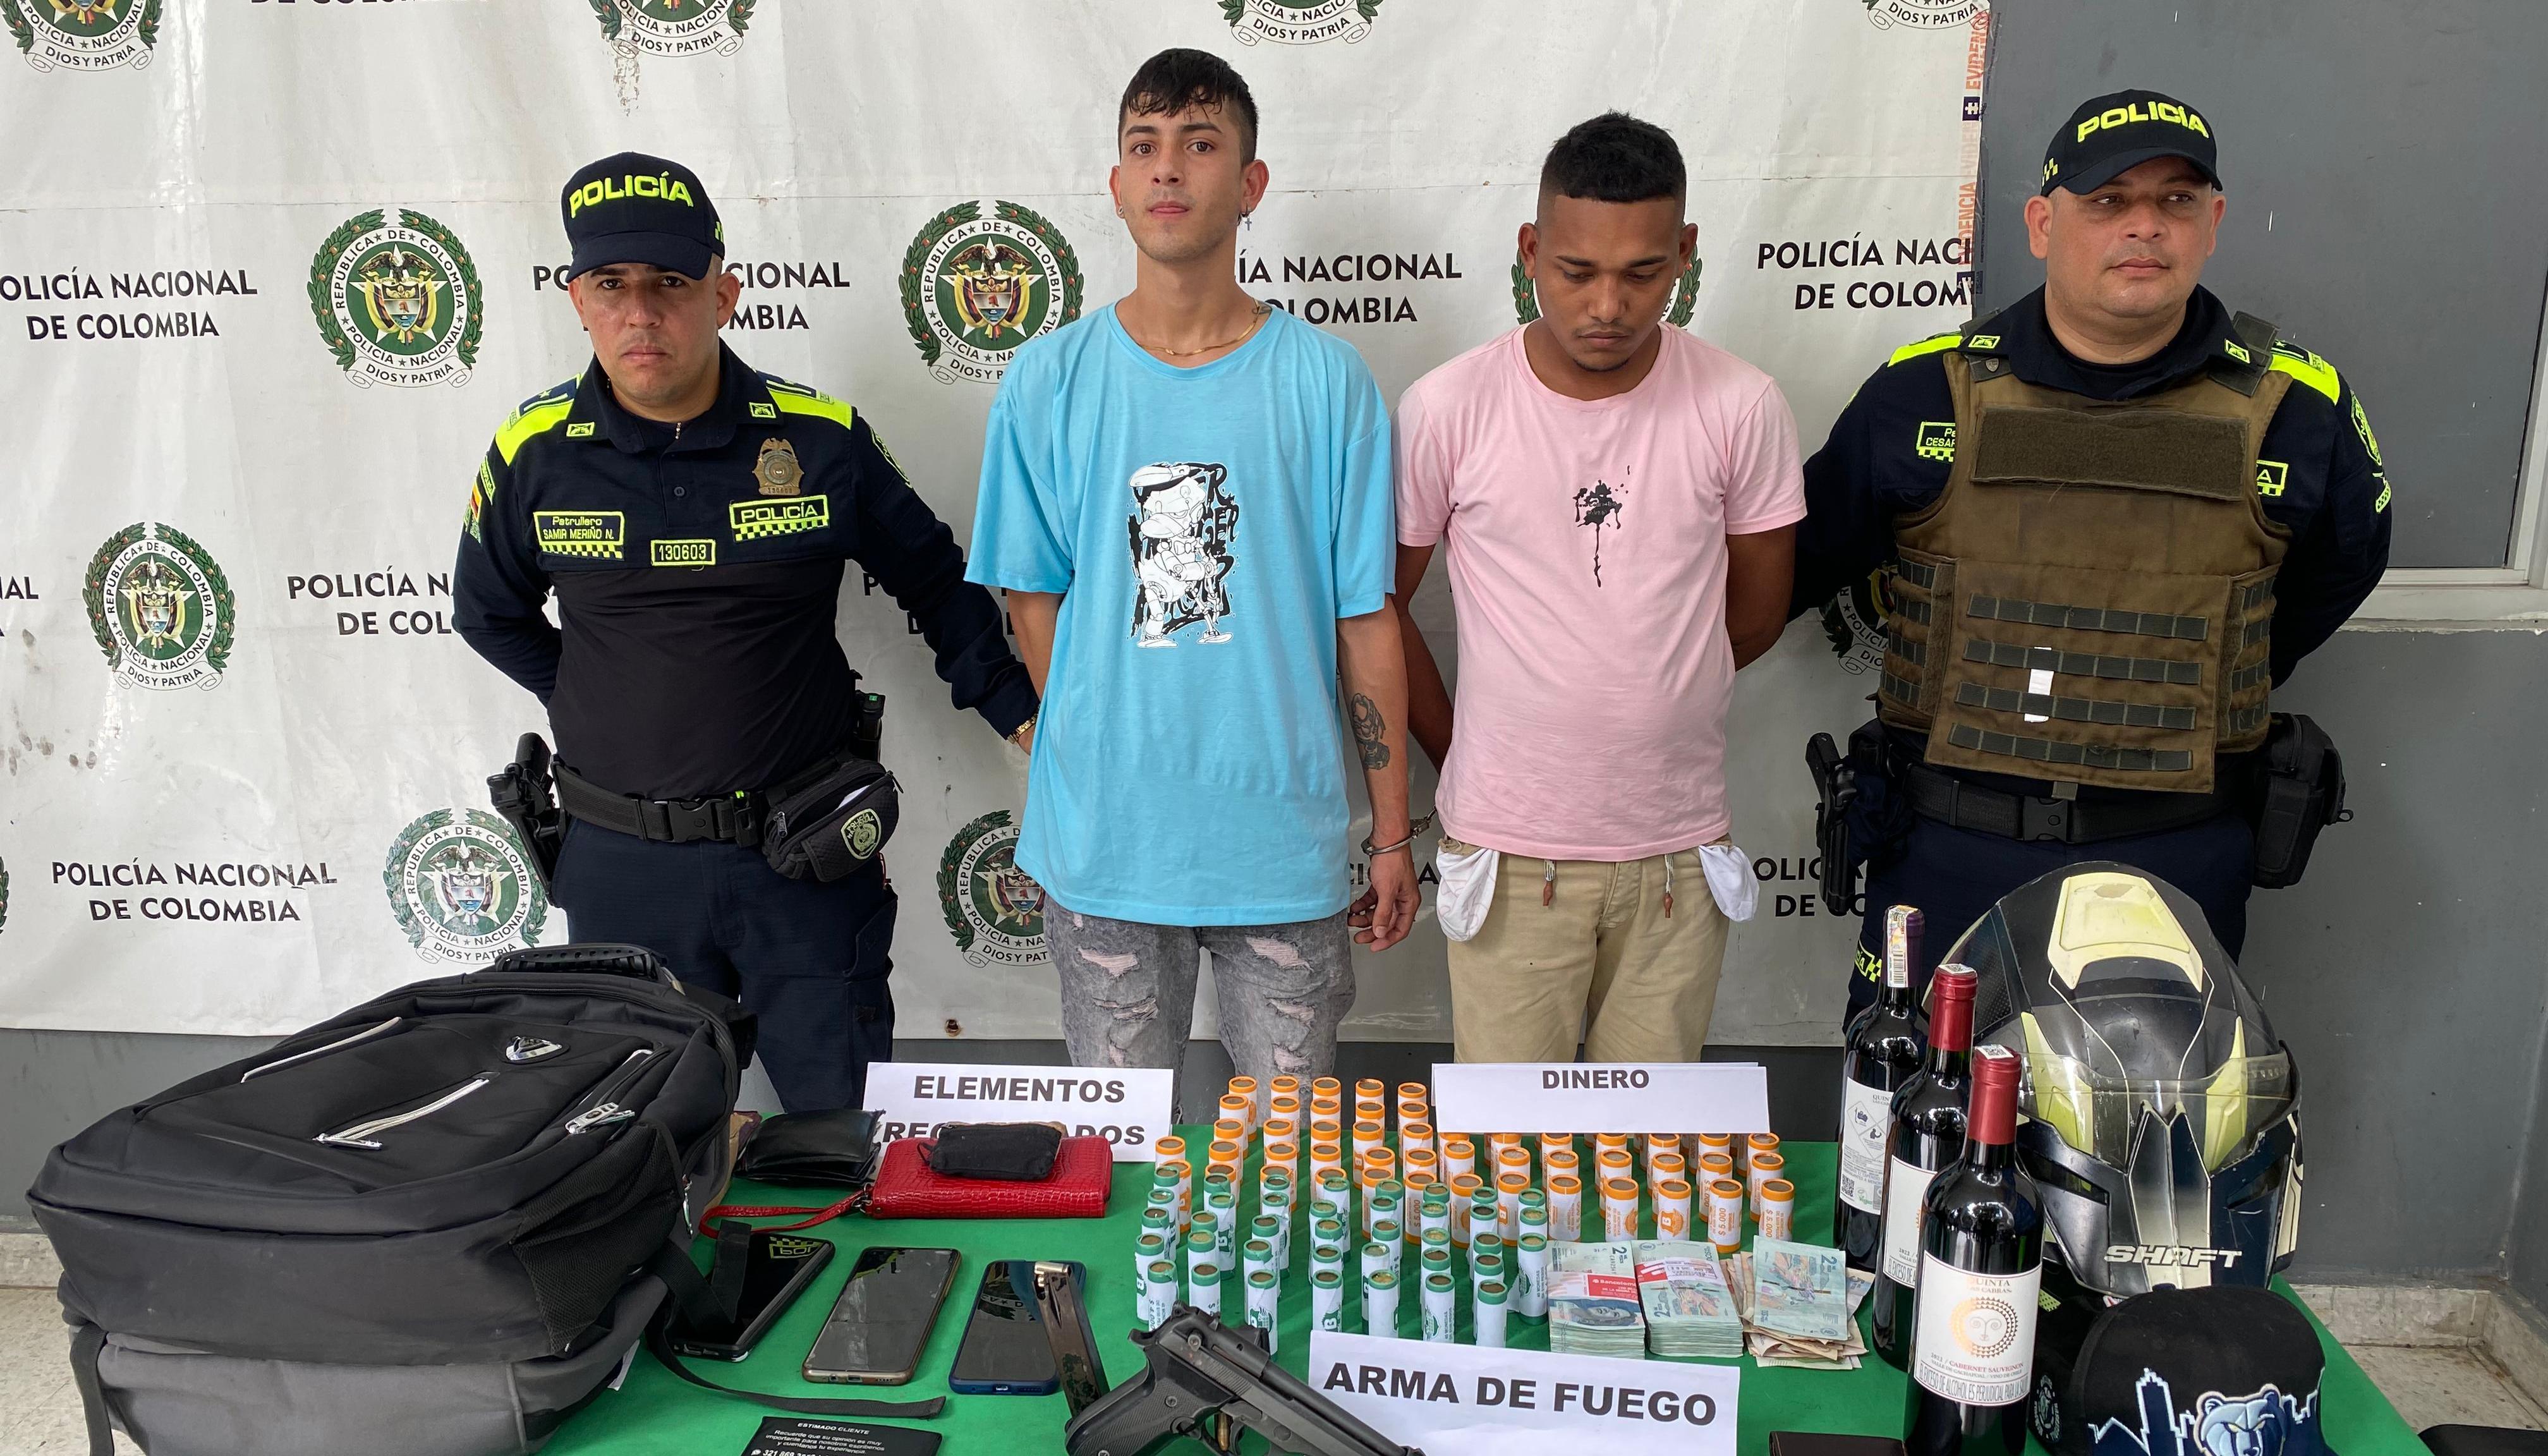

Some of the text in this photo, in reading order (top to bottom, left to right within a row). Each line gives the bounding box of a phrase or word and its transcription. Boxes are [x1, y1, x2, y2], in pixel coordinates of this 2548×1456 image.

[620, 0, 727, 33] OLICÍA NACION
[1302, 0, 1345, 21] NACIO
[1933, 3, 1978, 25] PATRIA
[92, 3, 143, 48] NACIONAL
[1302, 17, 1350, 40] PATRIA
[677, 30, 723, 52] PATRIA
[95, 44, 136, 66] PATRIA
[2078, 101, 2209, 143] POLICÍA
[570, 171, 694, 219] POLICÍA
[925, 222, 1060, 303] REPÚBLICA DE COLOMBIA
[1758, 232, 1972, 269] POLICÍA NACI
[334, 230, 464, 308] REPÚBLICA DE COLOMBIA
[725, 262, 850, 289] CIONAL
[1283, 253, 1462, 282] NACIONAL
[0, 266, 257, 301] OLICÍA NACIONAL
[1795, 280, 1972, 310] DE COLOM
[27, 311, 219, 341] DE COLOMBIA
[729, 303, 809, 330] MBIA
[410, 325, 462, 367] NACIONAL
[412, 363, 453, 384] PATRIA
[552, 516, 602, 526] Patrullero
[741, 502, 818, 523] POLICÍA
[543, 529, 567, 540] SAMIR
[569, 526, 602, 540] MERIÑO
[658, 544, 707, 561] 130603
[106, 542, 214, 617] REPÚBLICA DE COLOMBIA
[289, 565, 420, 599] POLICÍA
[337, 612, 381, 636] DE
[161, 631, 212, 671] NACIONAL
[1860, 650, 1884, 666] DIO
[162, 669, 203, 687] PATRIA
[52, 857, 337, 887] POLICÍA NACIONAL
[406, 827, 529, 896] REPÚBLICA DE COLOMBIA
[960, 833, 1000, 895] REPÚBLICA
[89, 897, 300, 922] DE COLOMBIA
[1775, 894, 1816, 917] DE
[475, 910, 526, 946] NACIONAL
[1026, 951, 1048, 962] PAT
[914, 1076, 1125, 1103] ELEMENTOS
[1542, 1069, 1649, 1089] DINERO
[1872, 1094, 1891, 1102] QUIN
[883, 1122, 1145, 1145] RECDOS
[2103, 1244, 2242, 1268] SHAFT
[1950, 1361, 1987, 1373] CABERNET
[1988, 1362, 2023, 1373] SAUVIGNON
[1324, 1362, 1716, 1426] ARMA DE FUEGO
[1924, 1368, 1939, 1388] EXCESO
[1939, 1374, 1946, 1390] DE
[1946, 1376, 1967, 1398] ALCOHOL
[765, 1434, 848, 1448] importante para nosotros
[774, 1429, 806, 1438] Recuerde
[798, 1423, 870, 1435] ESTIMADO CLIENTE
